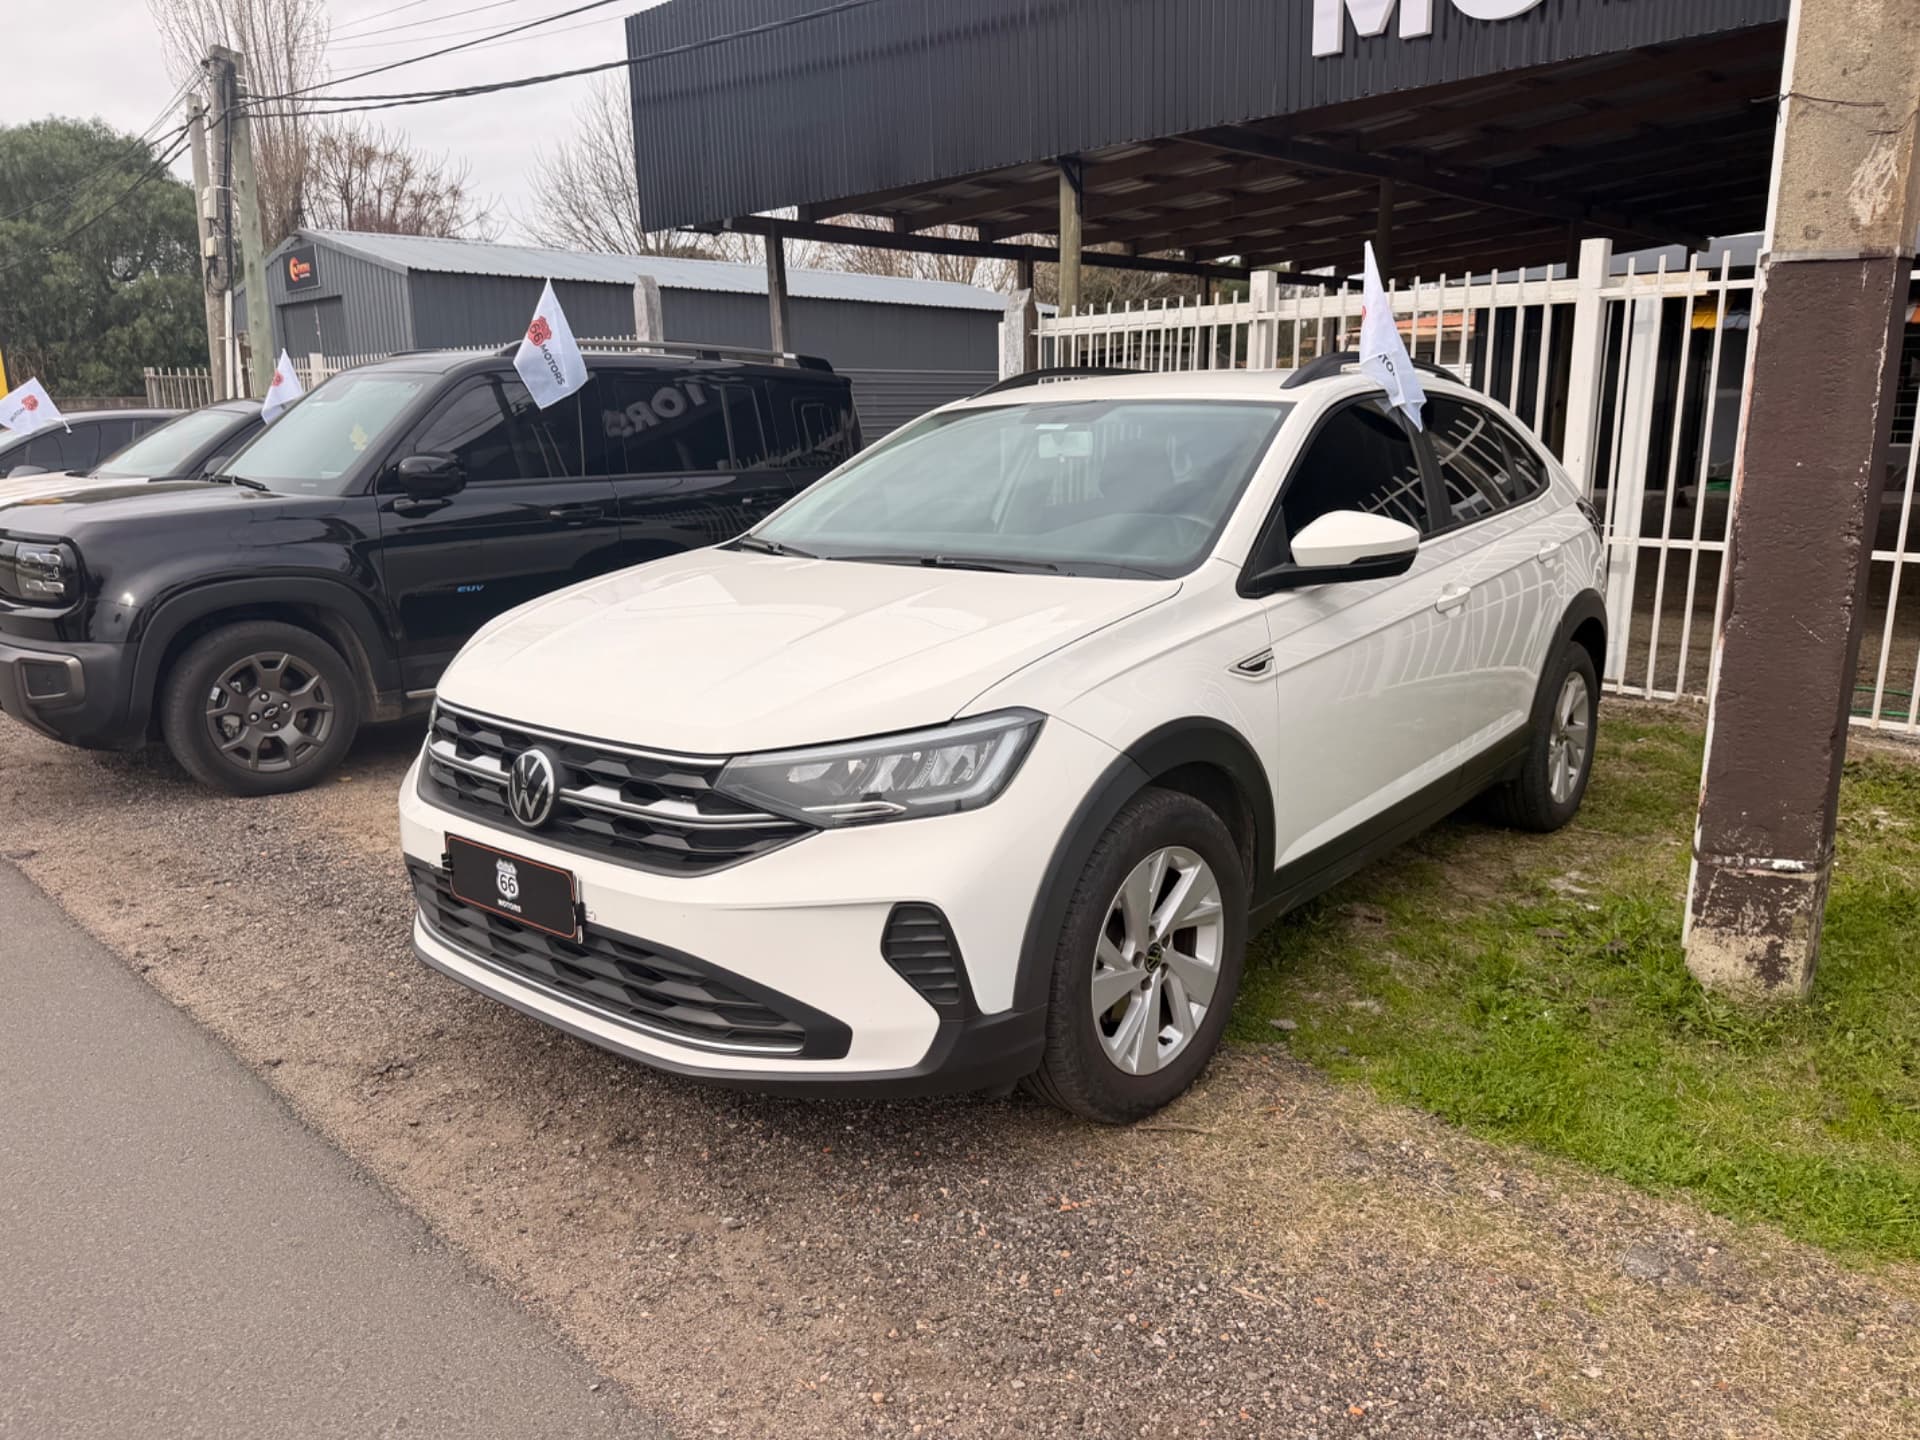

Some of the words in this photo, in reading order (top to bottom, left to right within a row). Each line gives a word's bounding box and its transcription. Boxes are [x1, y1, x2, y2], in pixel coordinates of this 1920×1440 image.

[530, 323, 544, 342] 66
[541, 344, 566, 385] MOTORS
[500, 874, 516, 894] 66
